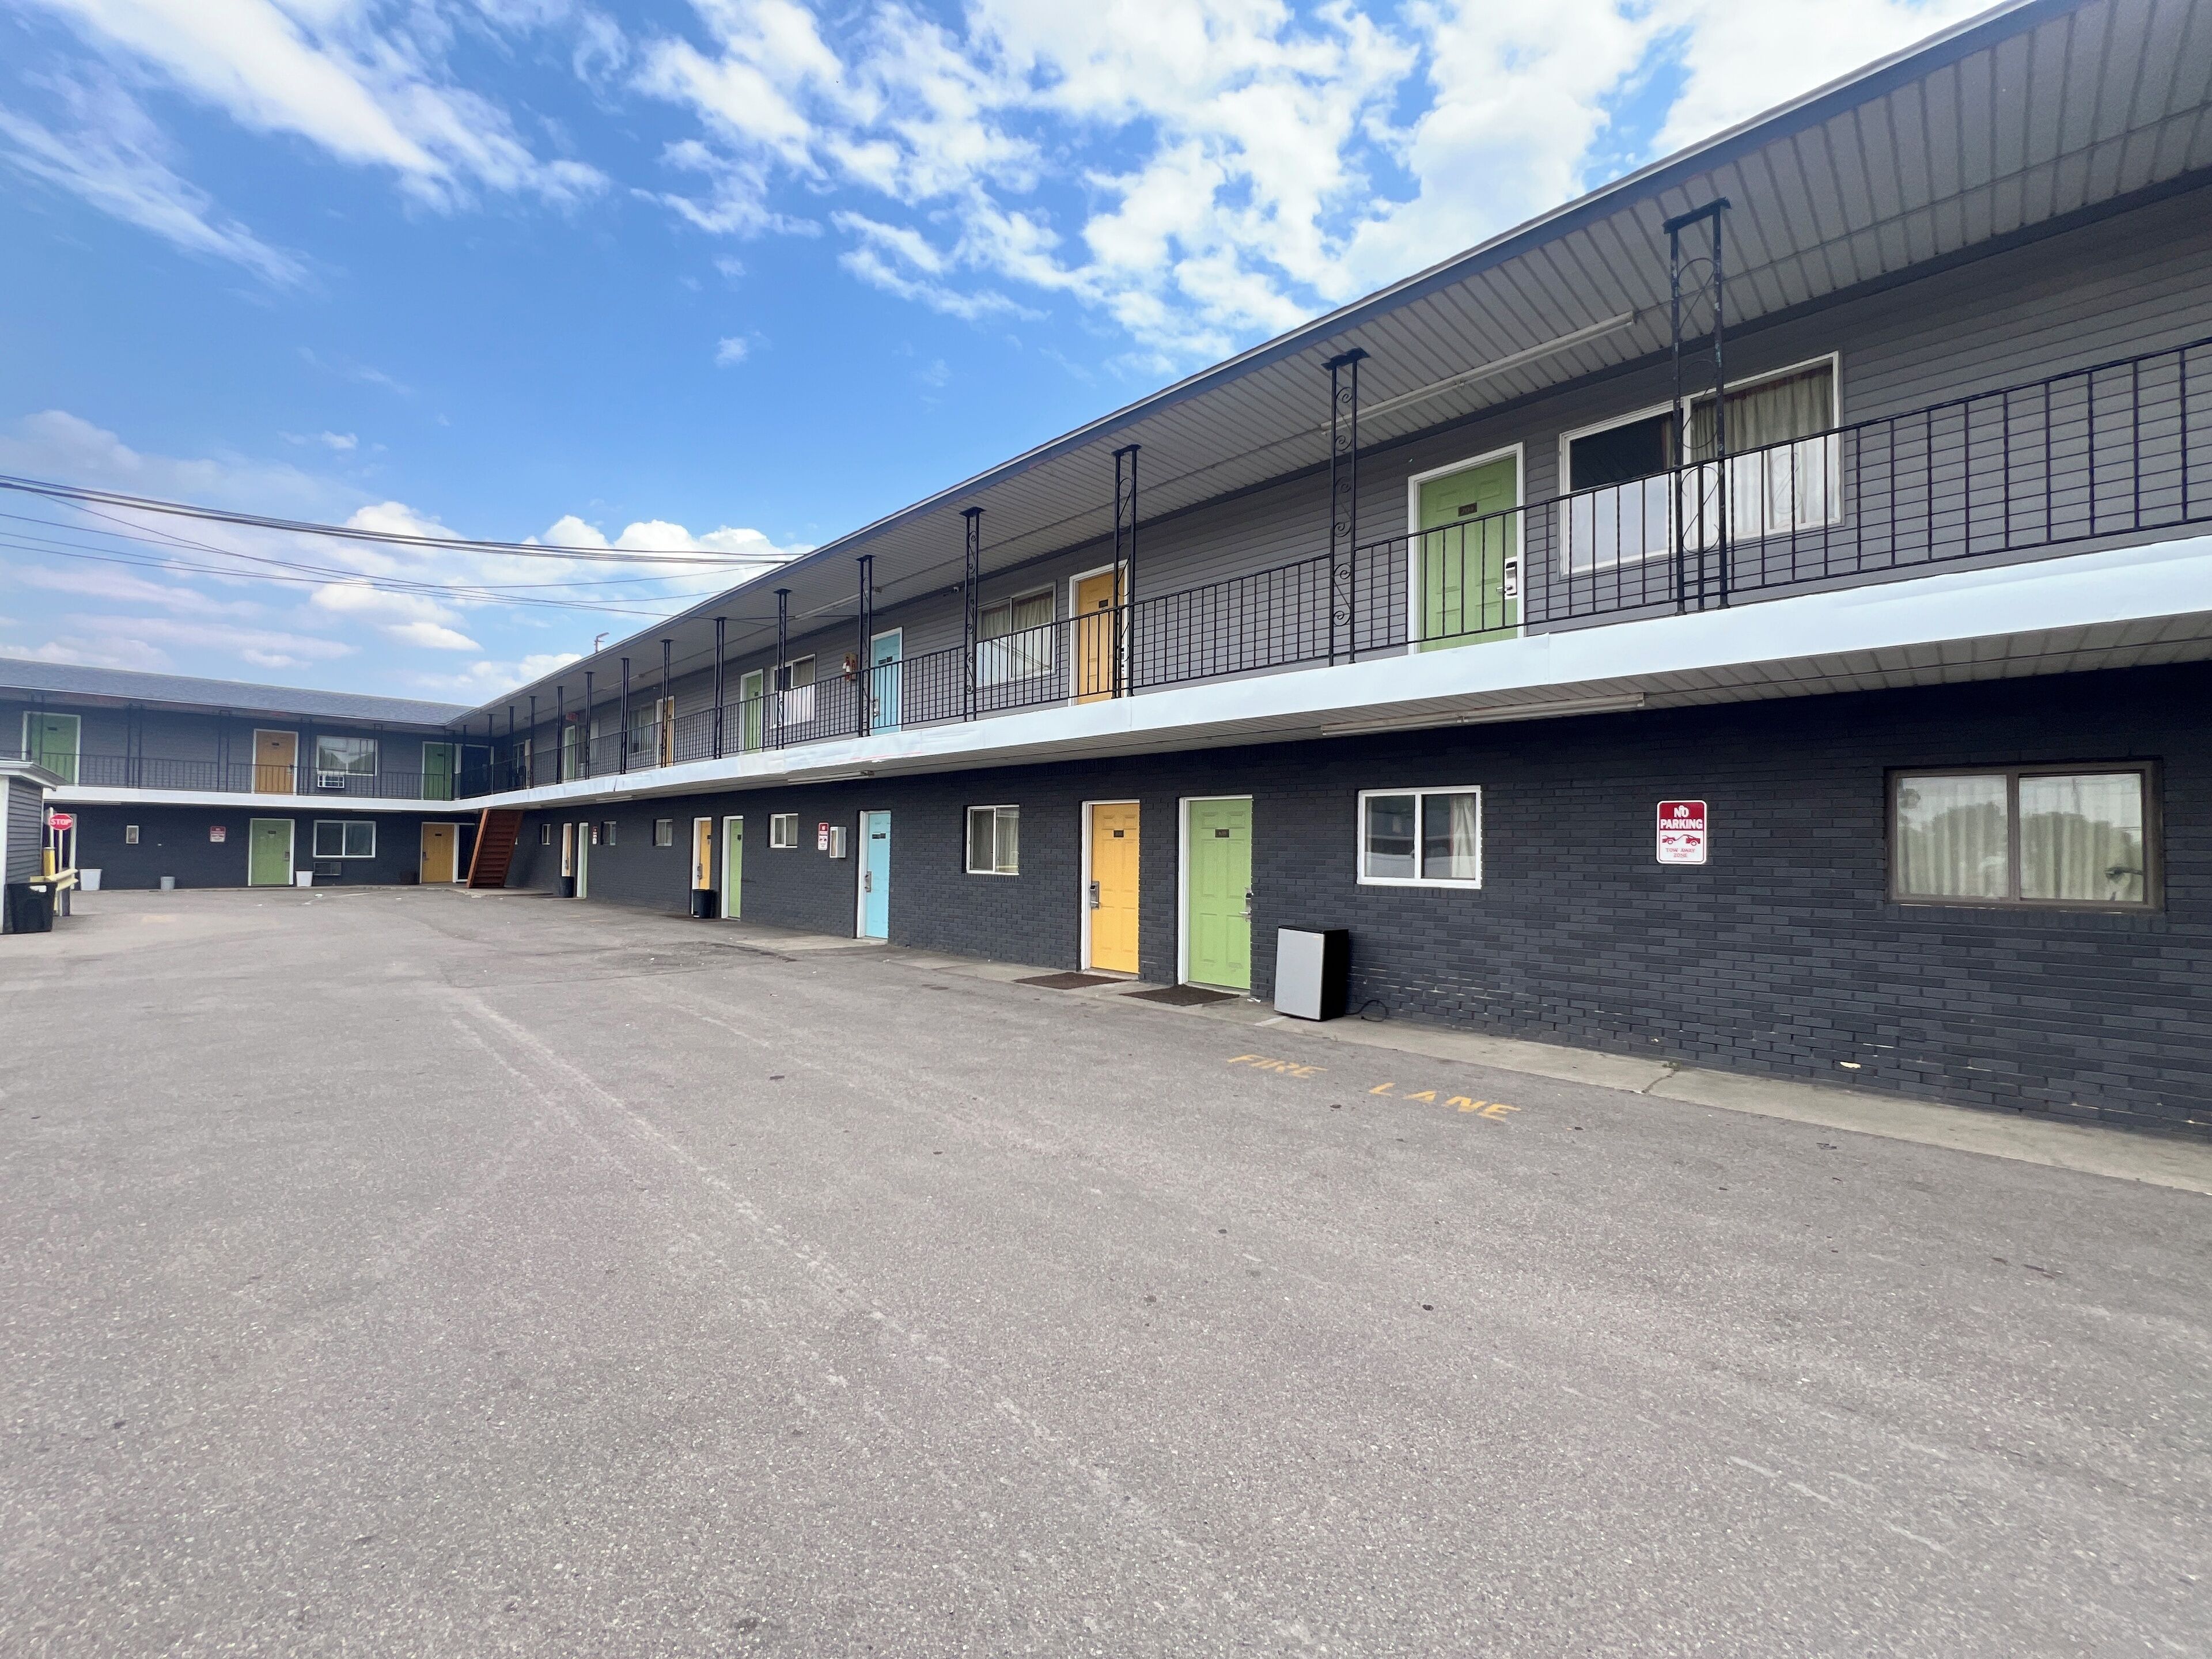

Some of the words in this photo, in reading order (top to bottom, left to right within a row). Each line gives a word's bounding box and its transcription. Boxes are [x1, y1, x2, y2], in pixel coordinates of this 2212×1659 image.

[1673, 807, 1689, 818] NO
[1660, 819, 1703, 829] PARKING
[1226, 1054, 1328, 1078] FIRE
[1369, 1082, 1522, 1123] LANE
